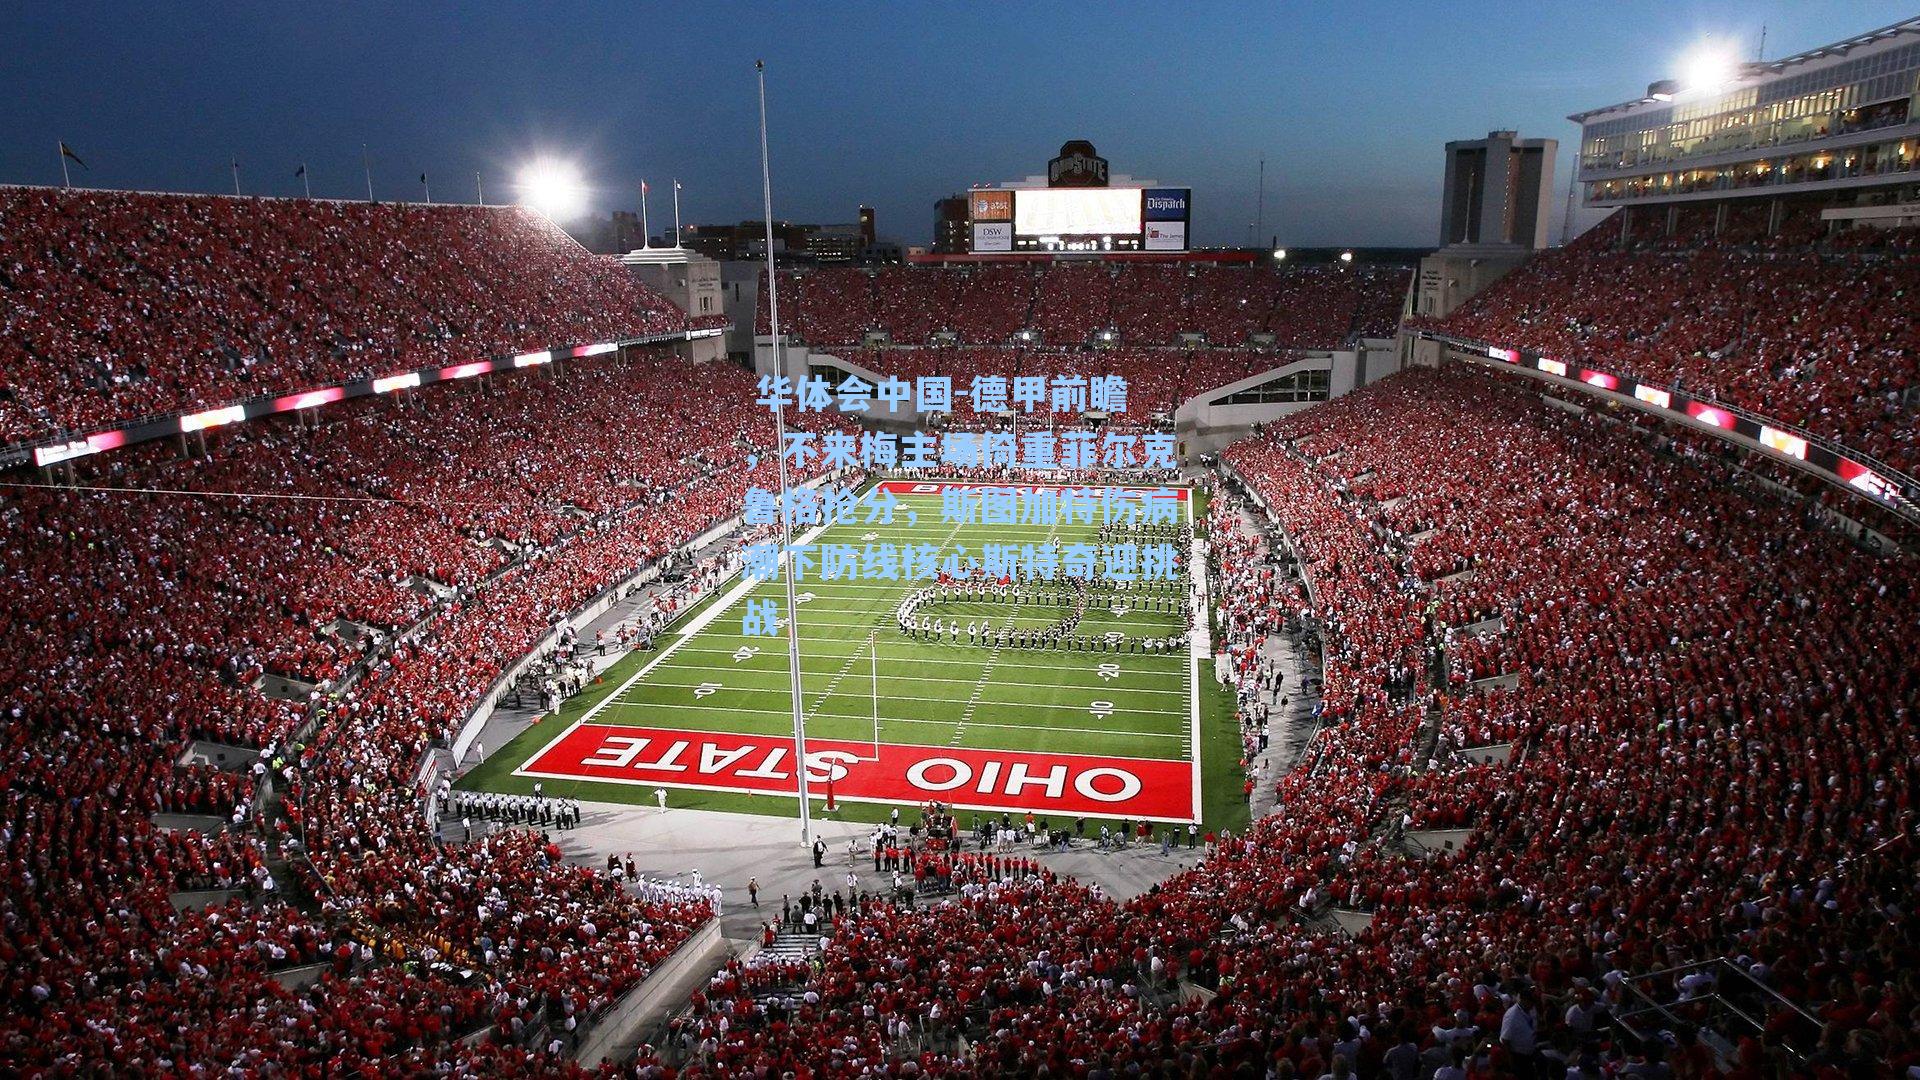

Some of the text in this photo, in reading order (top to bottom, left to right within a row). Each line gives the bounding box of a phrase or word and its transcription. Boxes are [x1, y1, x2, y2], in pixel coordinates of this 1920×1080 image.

[1147, 197, 1185, 210] Dispatch
[983, 228, 1002, 236] DSW
[1097, 663, 1120, 678] 20
[1089, 701, 1114, 715] 10
[580, 736, 1143, 802] OHIO STATE
